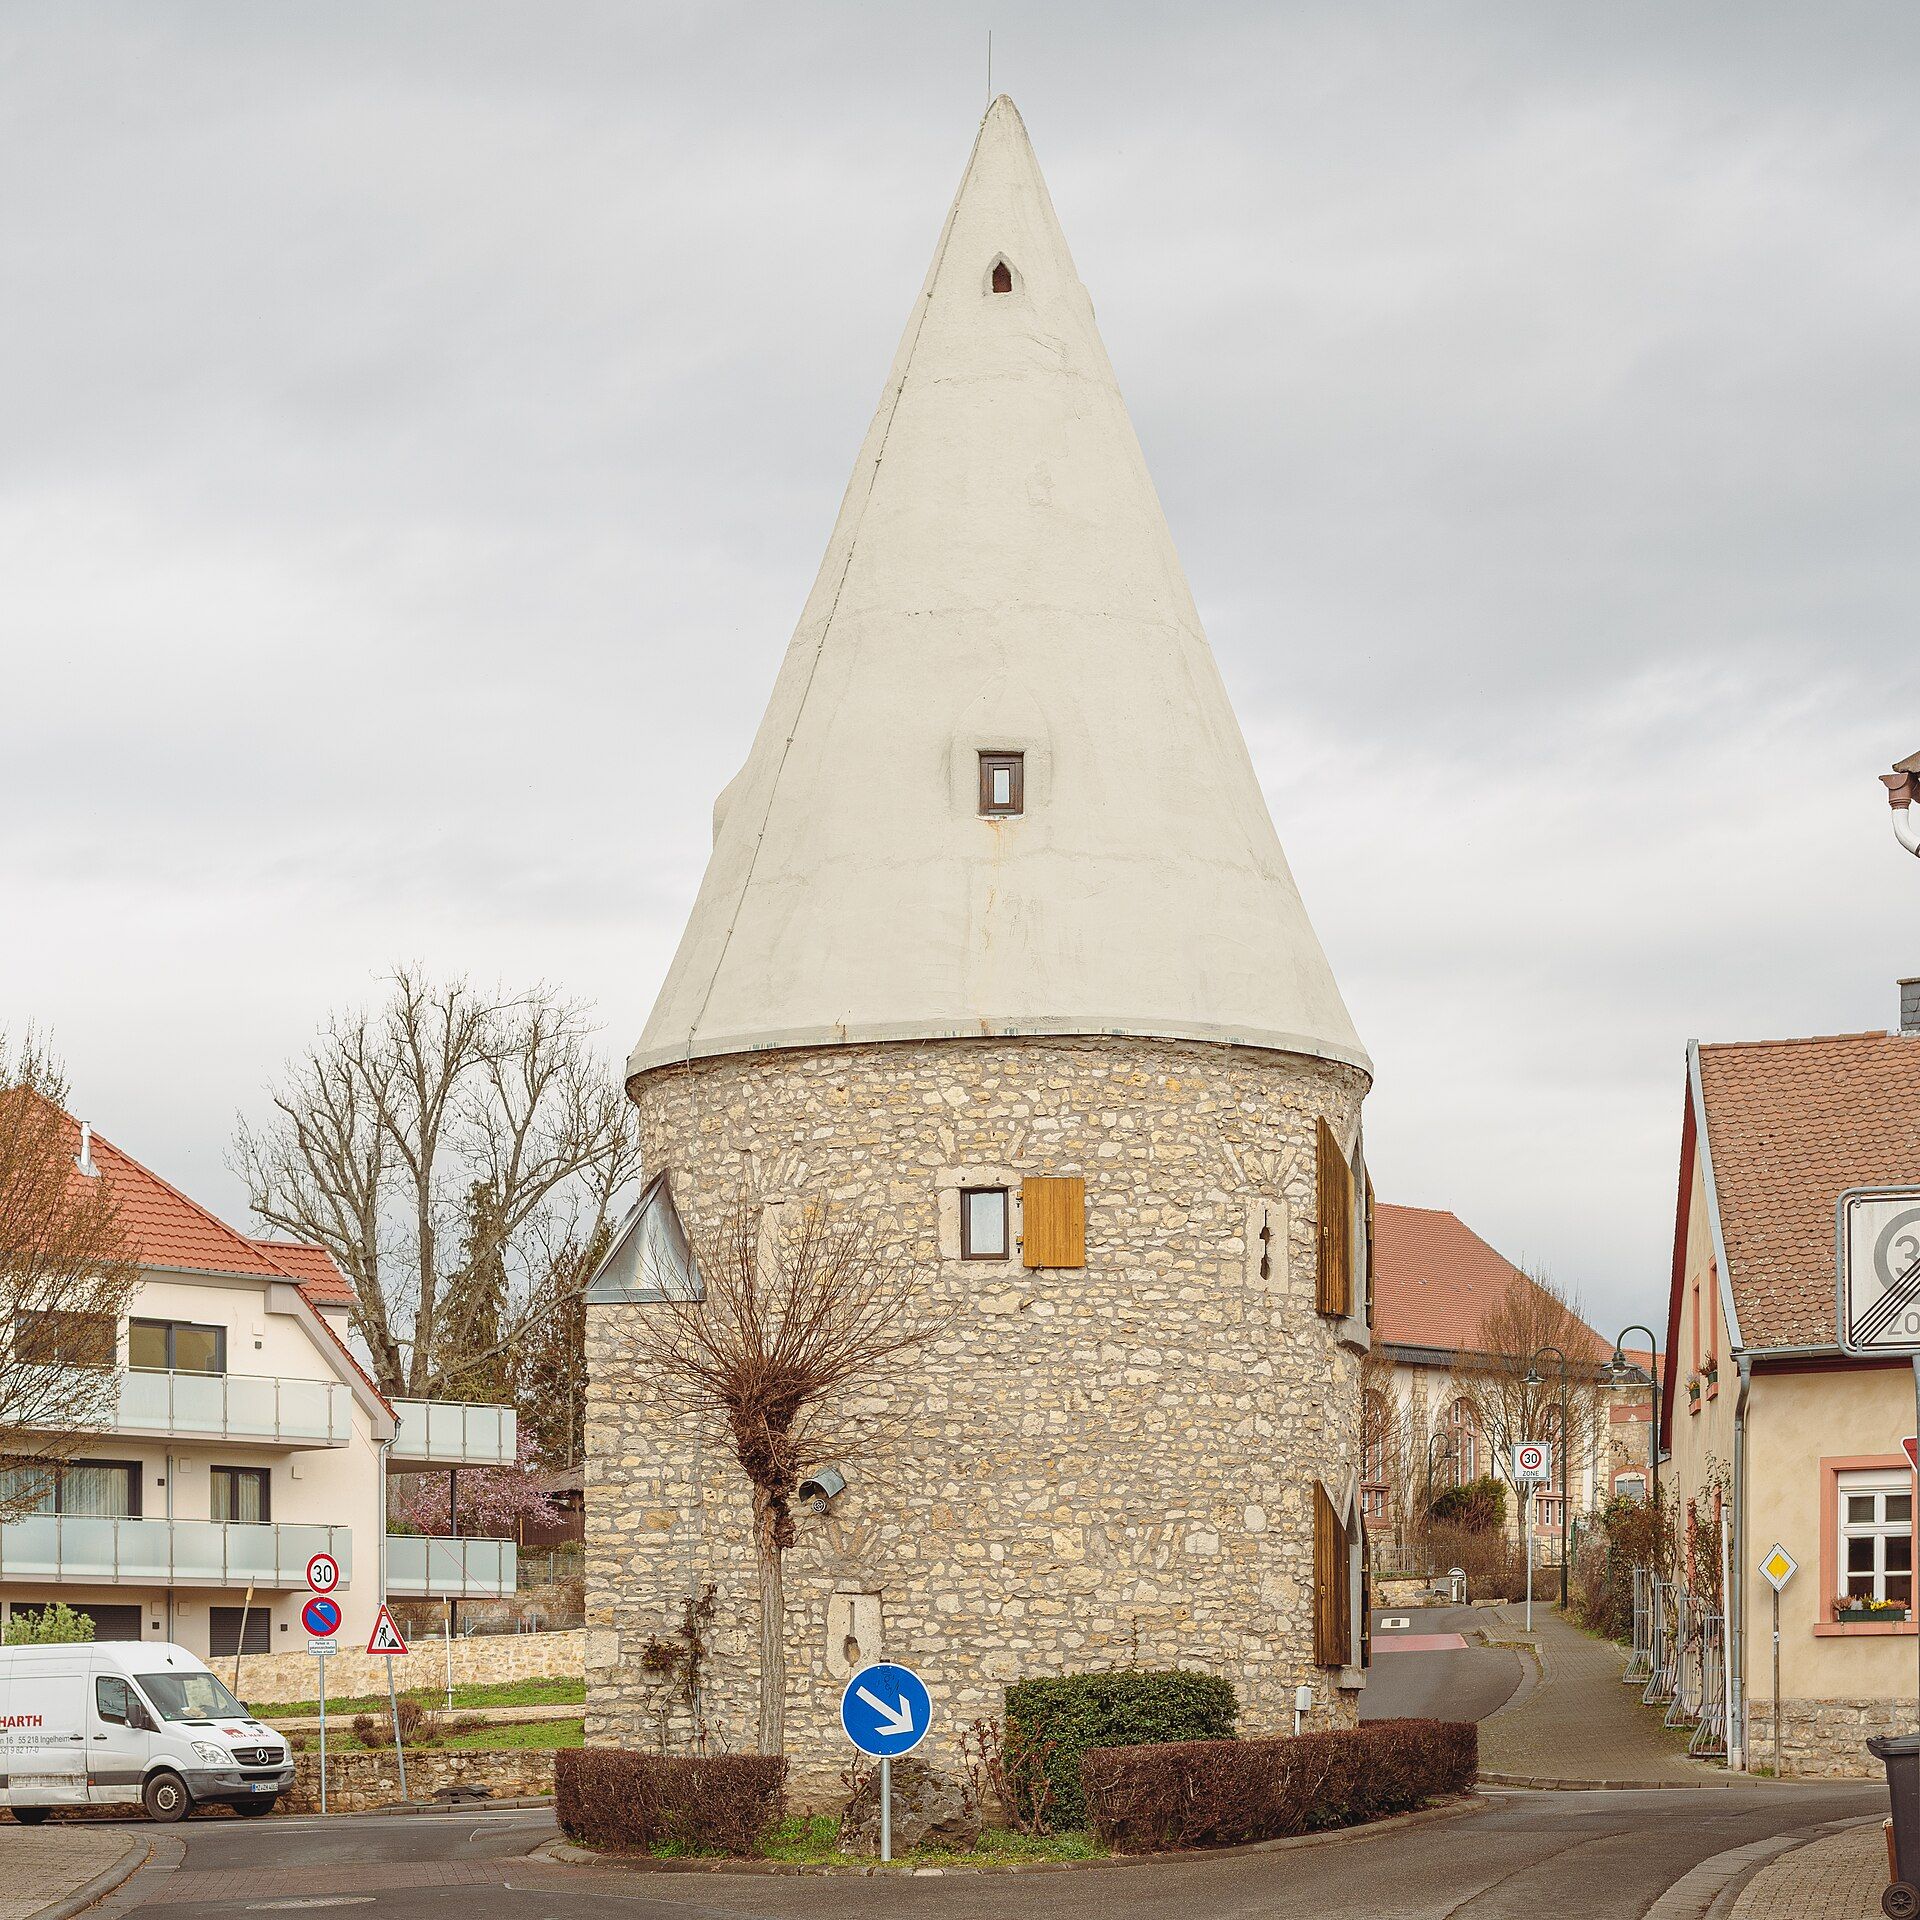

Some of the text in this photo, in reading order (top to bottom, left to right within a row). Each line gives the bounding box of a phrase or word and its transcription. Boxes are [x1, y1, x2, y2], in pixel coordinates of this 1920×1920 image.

[1524, 1454, 1538, 1464] 30
[313, 1564, 332, 1583] 30
[0, 1715, 42, 1727] HARTH
[6, 1736, 14, 1744] 16
[18, 1736, 26, 1744] 55
[27, 1735, 39, 1744] 218
[40, 1735, 70, 1745] Ingelheim
